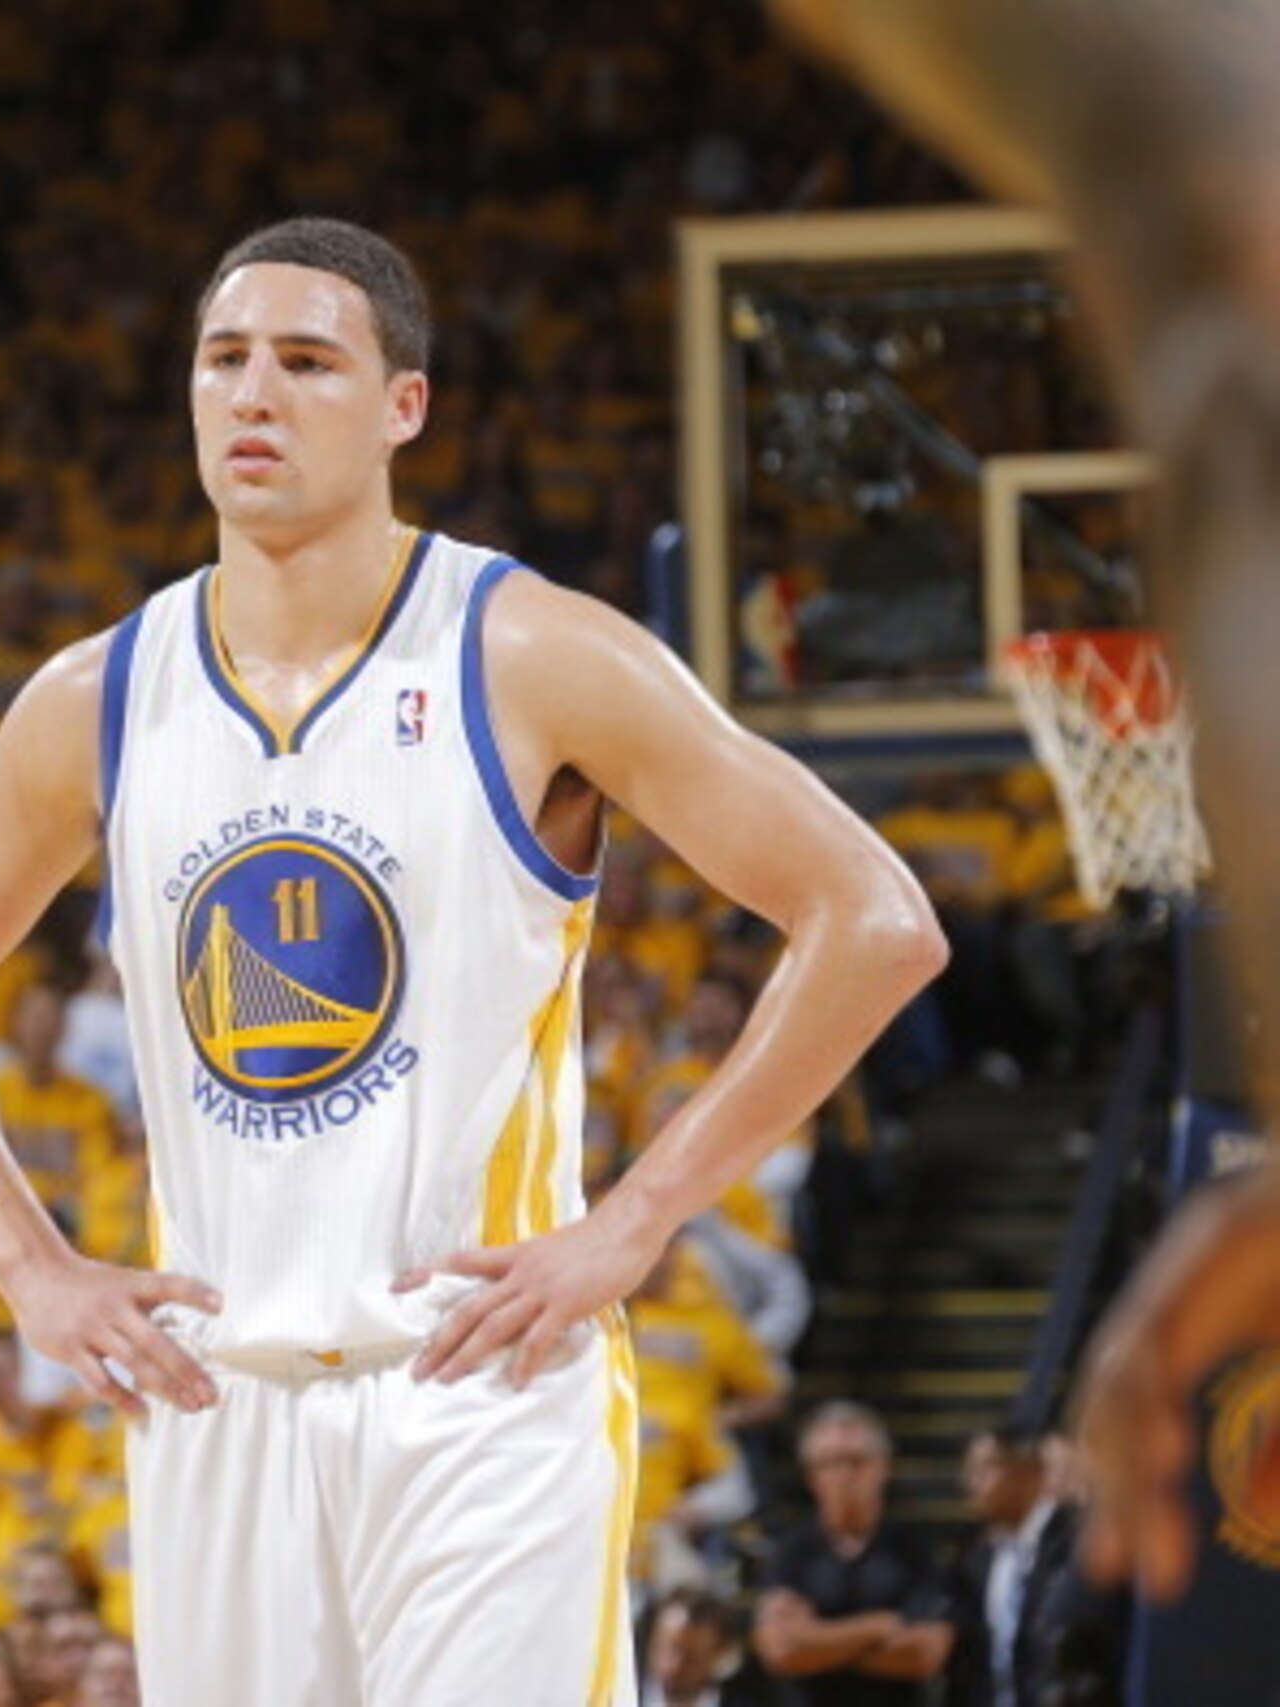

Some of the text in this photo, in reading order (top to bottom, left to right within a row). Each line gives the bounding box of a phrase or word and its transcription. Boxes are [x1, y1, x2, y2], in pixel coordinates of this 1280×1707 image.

[163, 804, 403, 903] GOLDEN STATE
[272, 876, 321, 944] 11
[192, 1038, 420, 1142] WARRIORS
